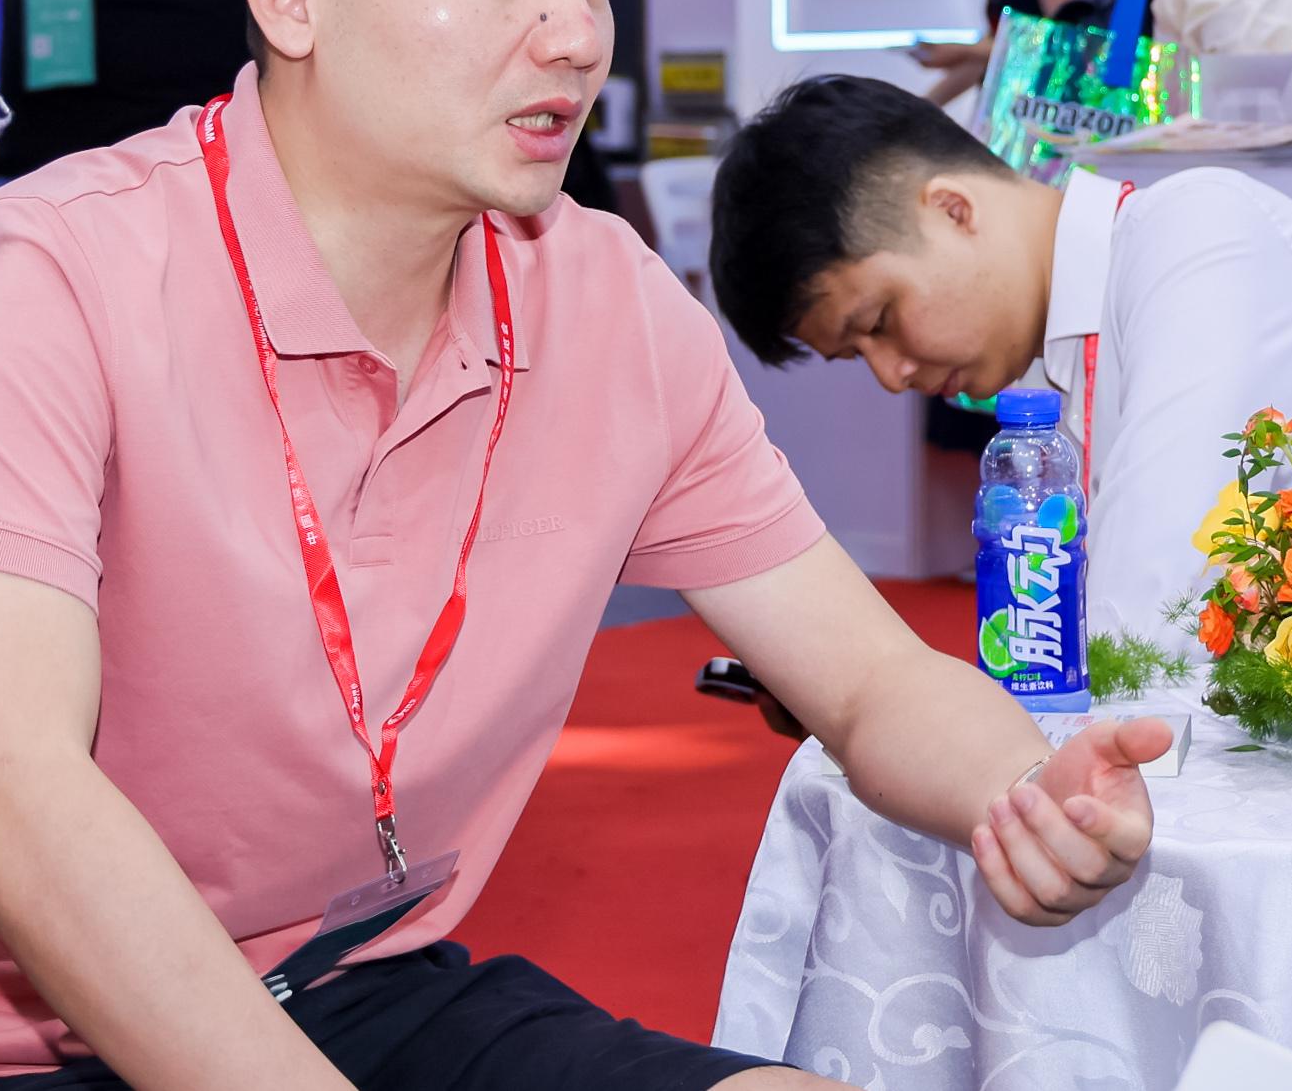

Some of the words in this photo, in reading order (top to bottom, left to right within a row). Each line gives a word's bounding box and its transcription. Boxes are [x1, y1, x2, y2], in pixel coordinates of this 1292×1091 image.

[1010, 91, 1137, 138] amazon
[1001, 524, 1072, 673] 脉动
[1011, 680, 1054, 691] 维生素饮料
